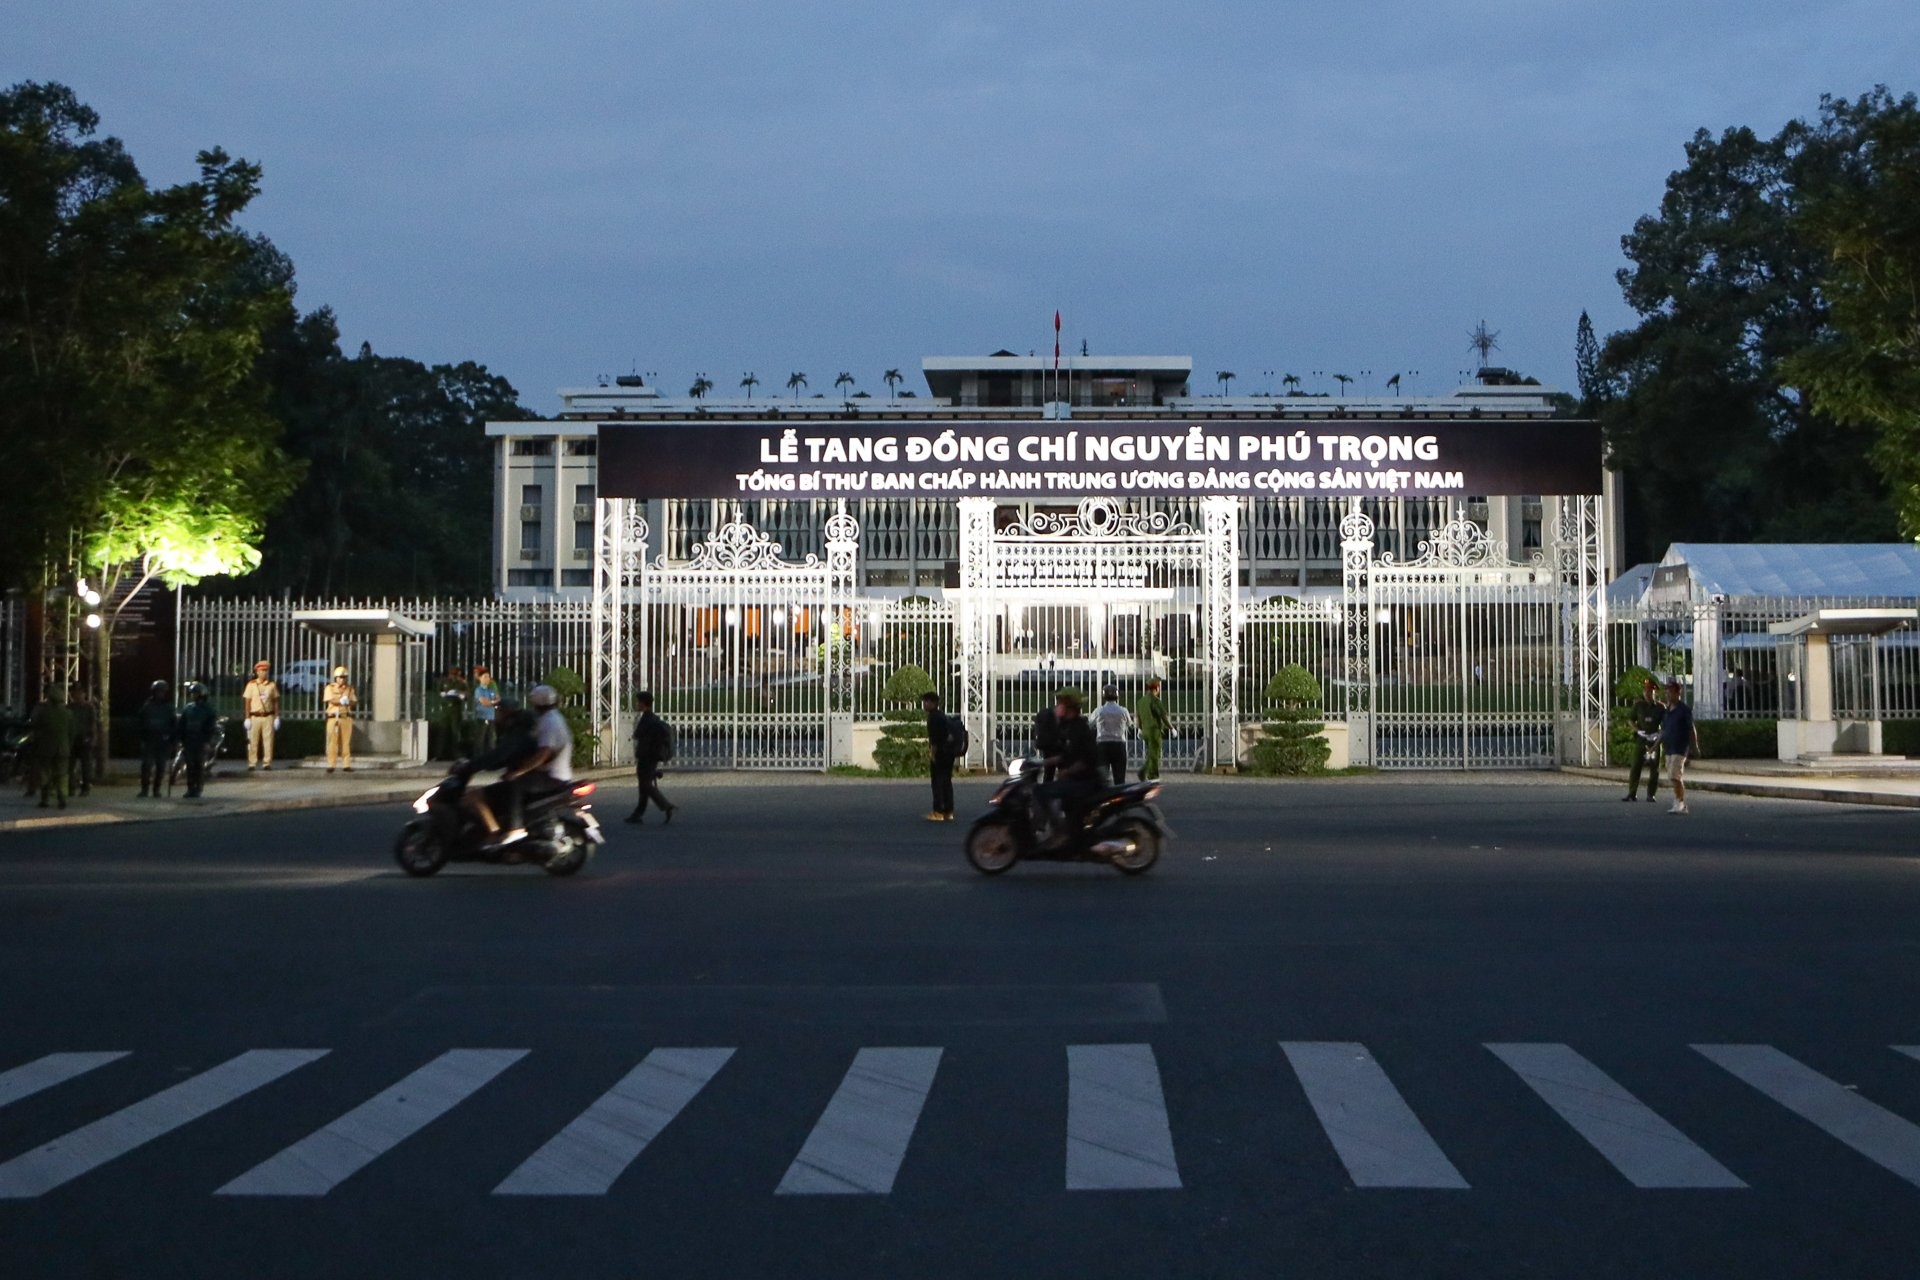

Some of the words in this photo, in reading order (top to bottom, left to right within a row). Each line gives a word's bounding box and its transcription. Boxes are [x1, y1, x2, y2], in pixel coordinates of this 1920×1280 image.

[760, 429, 798, 463] LỄ
[805, 437, 898, 462] TANG
[905, 429, 1009, 462] ĐỒNG
[1018, 431, 1078, 462] CHÍ
[1086, 426, 1230, 462] NGUYỄN
[1239, 430, 1310, 461] PHÚ
[1317, 435, 1438, 468] TRỌNG
[736, 468, 795, 491] TỔNG
[799, 471, 820, 491] BÍ
[822, 471, 868, 491] THƯ
[871, 472, 914, 490] BAN
[919, 468, 976, 490] CHẤP
[980, 469, 1041, 489] HÀNH
[1044, 472, 1116, 489] TRUNG
[1121, 470, 1184, 489] ƯƠNG
[1188, 467, 1250, 489] ĐẢNG
[1254, 468, 1315, 493] CỘNG
[1319, 467, 1361, 489] SẢN
[1365, 468, 1411, 493] VIỆT
[1415, 472, 1464, 489] NAM
